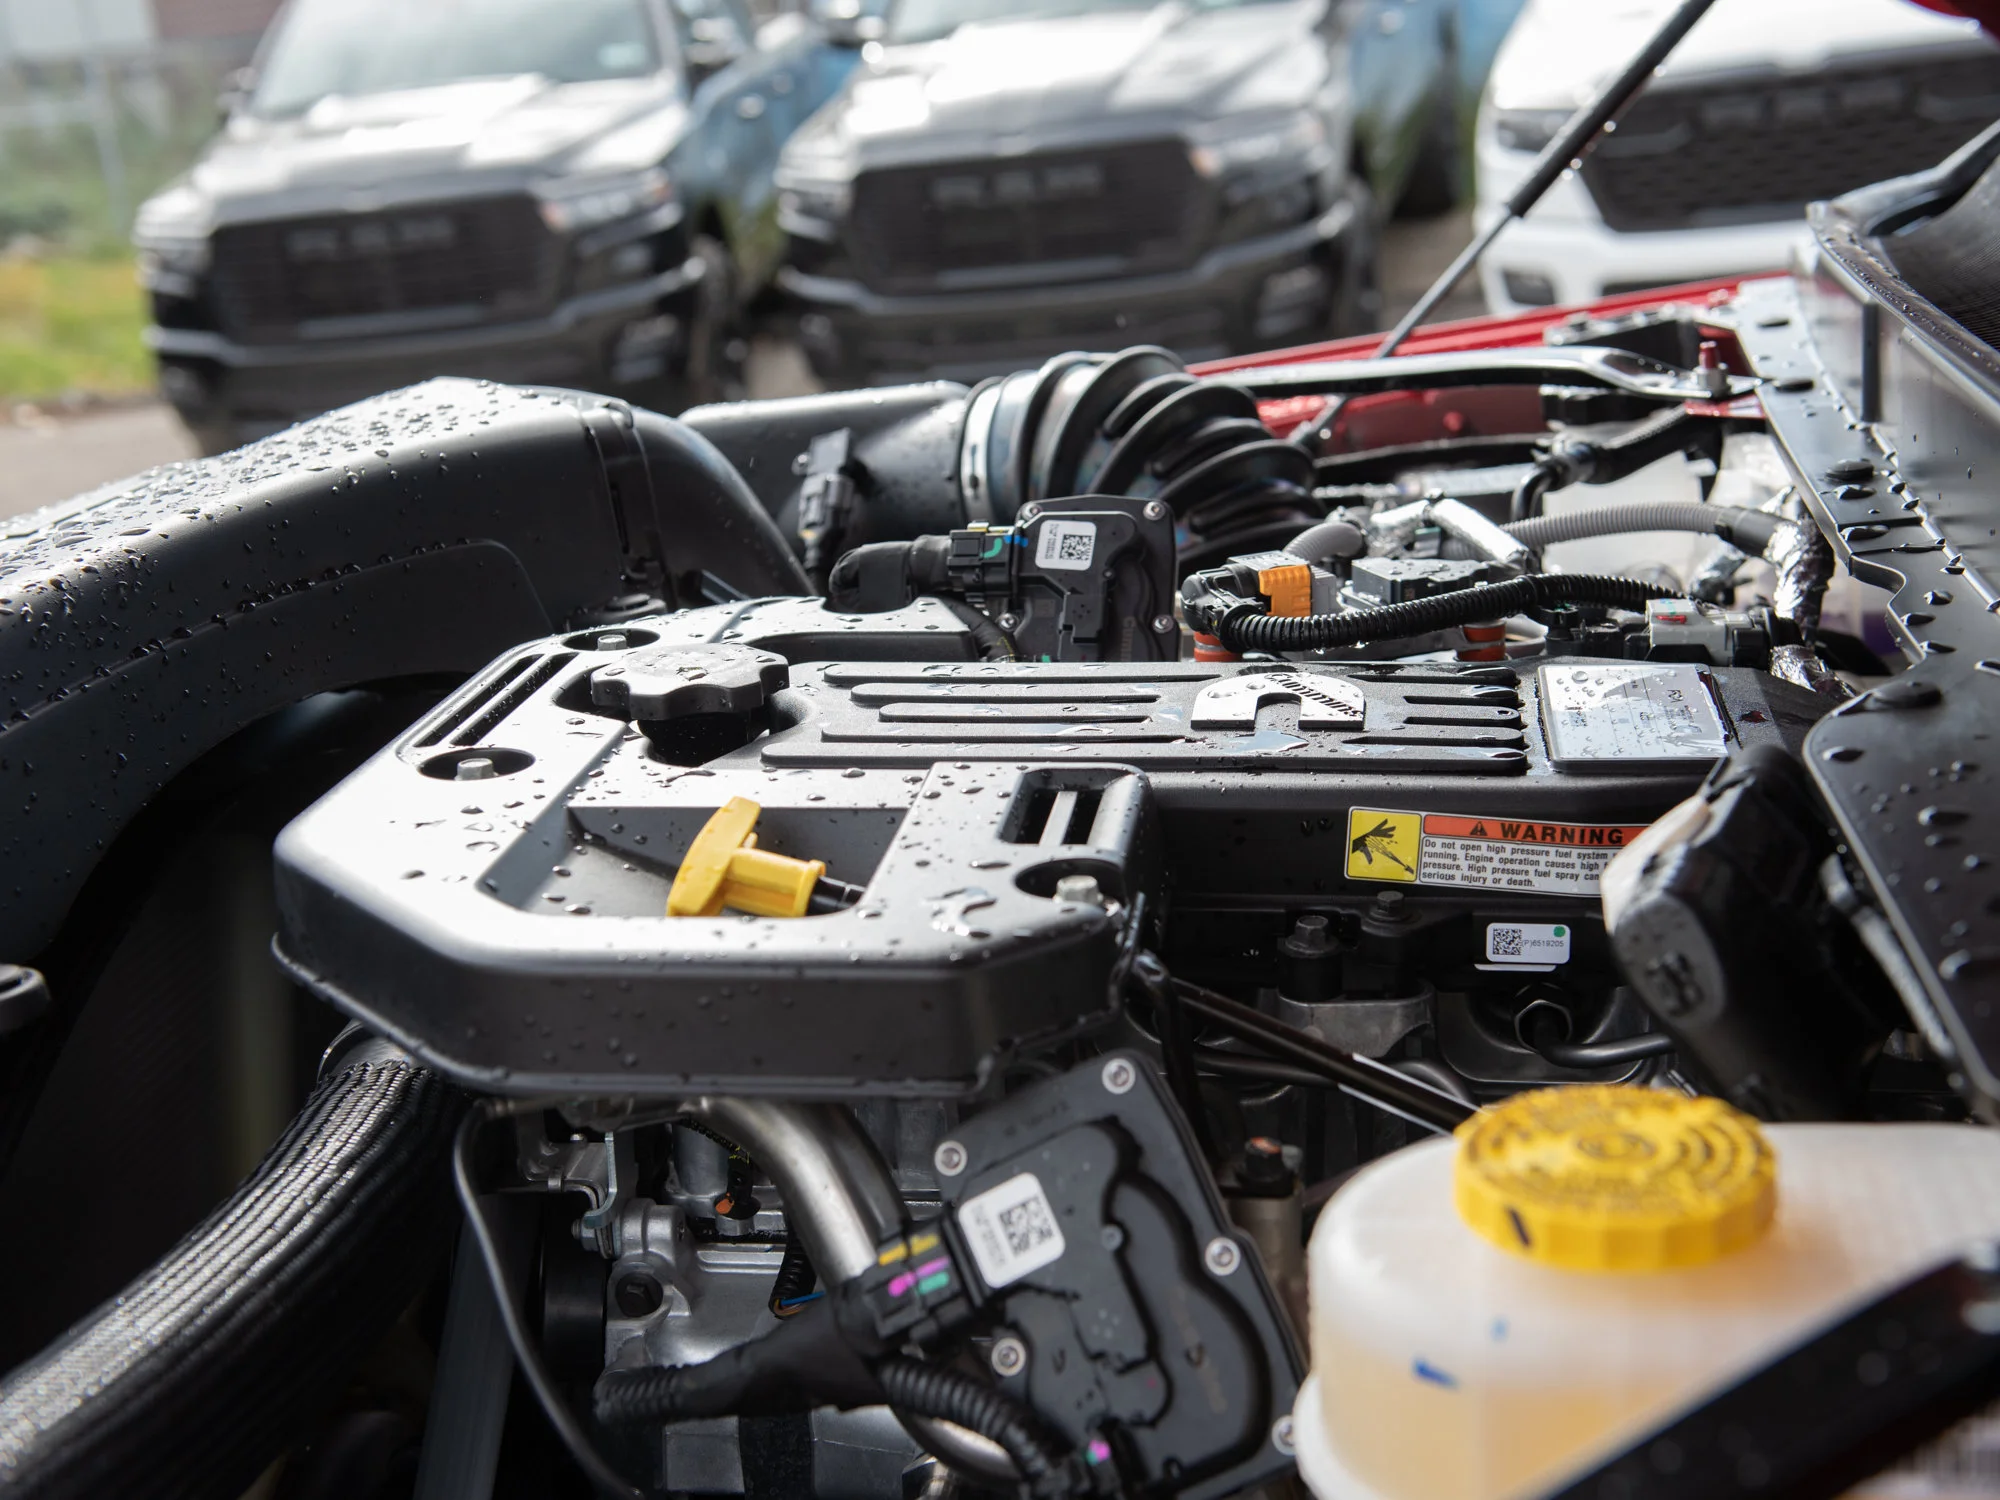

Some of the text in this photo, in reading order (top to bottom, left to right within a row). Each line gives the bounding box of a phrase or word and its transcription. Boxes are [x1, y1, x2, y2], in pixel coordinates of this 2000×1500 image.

[1120, 616, 1136, 662] Cumm
[1264, 673, 1363, 717] Cummins
[1500, 822, 1623, 845] WARNING
[1424, 839, 1437, 848] Do
[1441, 841, 1456, 850] not
[1460, 843, 1482, 852] open
[1486, 844, 1506, 855] high
[1511, 847, 1550, 857] pressure
[1555, 849, 1572, 859] fuel
[1577, 850, 1608, 860] system
[1422, 861, 1600, 882] pressure. High pressure fuel spray can
[1423, 851, 1460, 862] running.
[1465, 853, 1494, 863] Engine
[1498, 857, 1540, 867] operation
[1545, 860, 1576, 869] causes
[1580, 861, 1599, 871] high
[1422, 871, 1456, 881] serious
[1461, 873, 1488, 884] injury
[1507, 877, 1535, 887] death.
